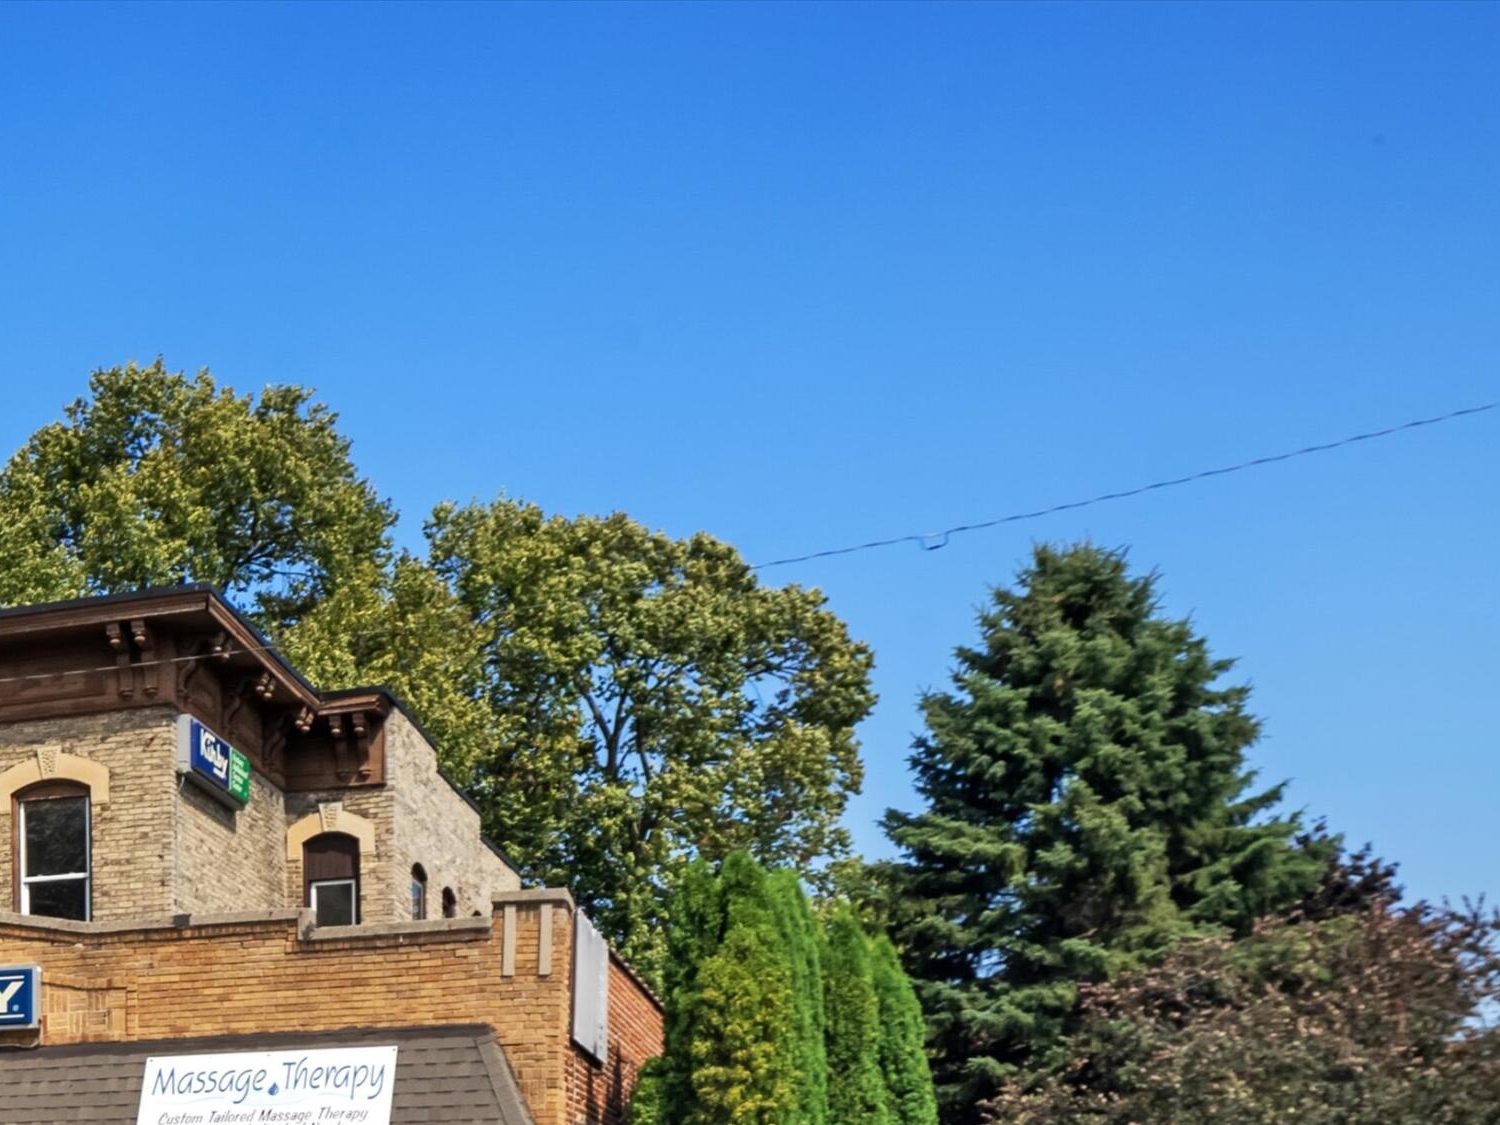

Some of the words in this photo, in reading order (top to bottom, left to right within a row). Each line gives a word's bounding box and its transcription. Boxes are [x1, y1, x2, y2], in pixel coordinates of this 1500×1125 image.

[152, 1067, 268, 1104] Massage
[283, 1056, 386, 1100] Therapy
[158, 1111, 204, 1125] Custom
[209, 1109, 257, 1124] Tailored
[259, 1108, 312, 1124] Massage
[318, 1106, 369, 1122] Therapy
